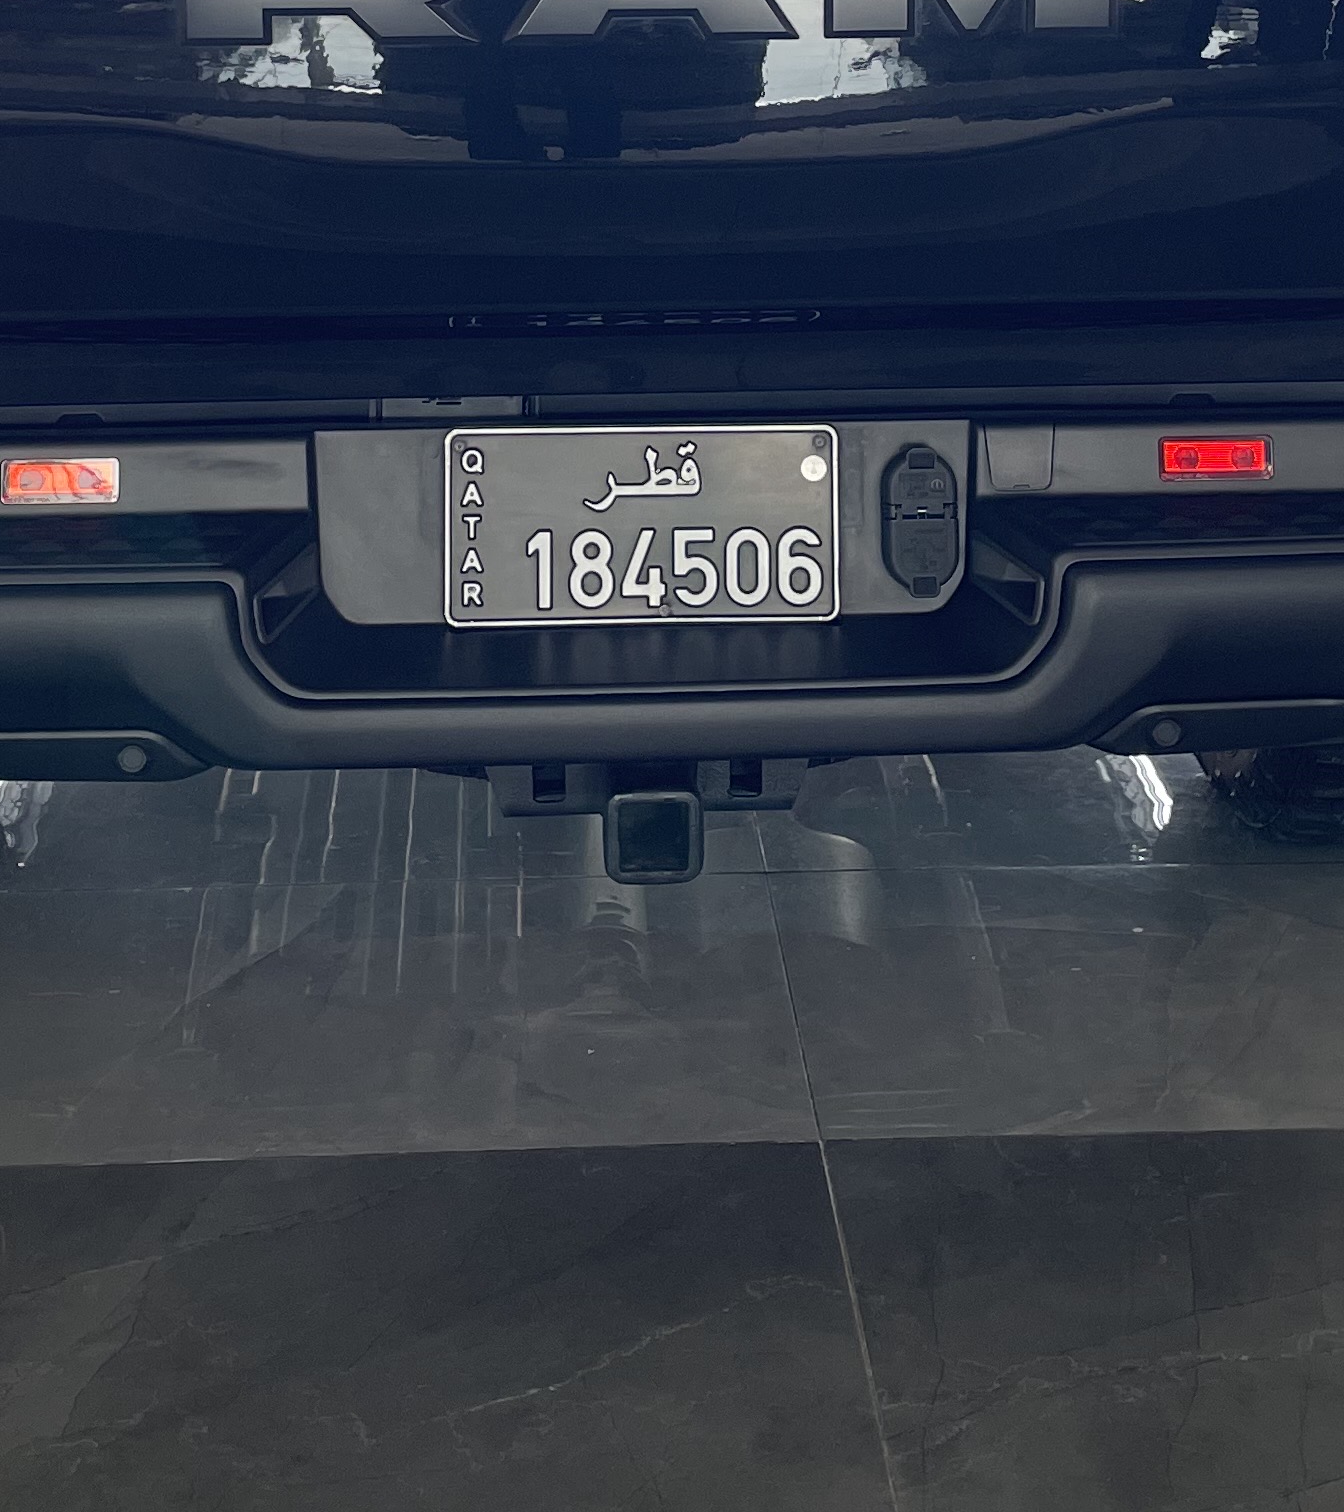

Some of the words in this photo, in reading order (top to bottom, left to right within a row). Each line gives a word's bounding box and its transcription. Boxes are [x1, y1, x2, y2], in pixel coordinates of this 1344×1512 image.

[583, 441, 702, 512] قطر
[459, 448, 486, 608] QATAR
[525, 525, 825, 611] 184506
